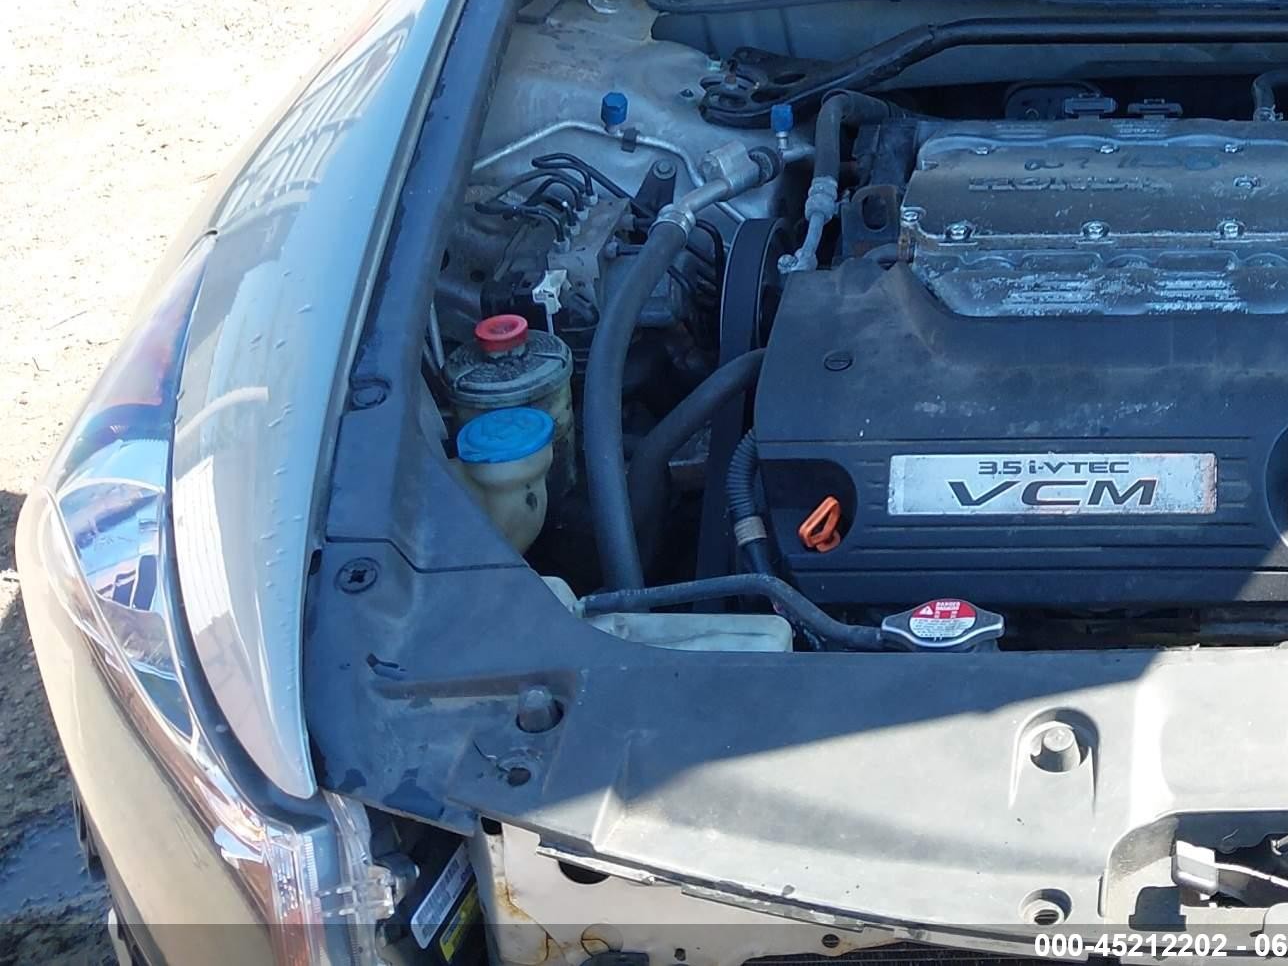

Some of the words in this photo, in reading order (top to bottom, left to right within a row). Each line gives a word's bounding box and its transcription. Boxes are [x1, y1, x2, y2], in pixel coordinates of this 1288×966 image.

[978, 460, 1022, 475] 3.5
[1028, 460, 1130, 474] i-VTEC
[947, 479, 1158, 507] VCM
